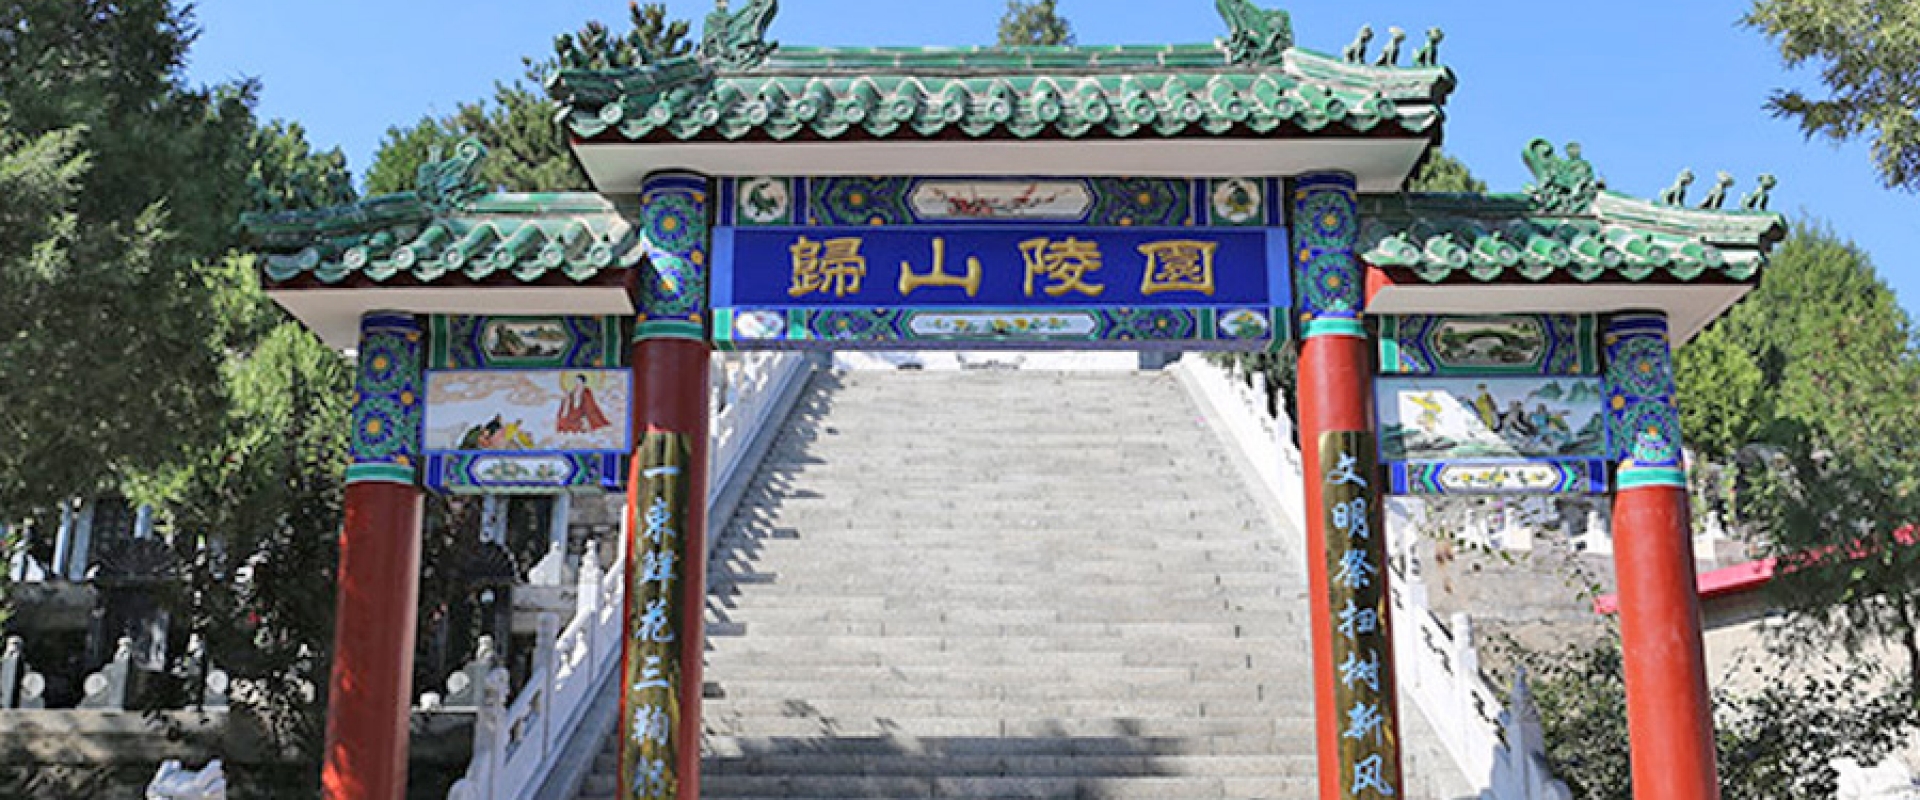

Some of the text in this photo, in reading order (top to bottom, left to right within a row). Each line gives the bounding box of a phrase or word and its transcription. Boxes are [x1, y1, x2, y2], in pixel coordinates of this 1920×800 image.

[788, 236, 1219, 298] 歸山陵園
[1327, 453, 1394, 796] 文明祭扫树新风
